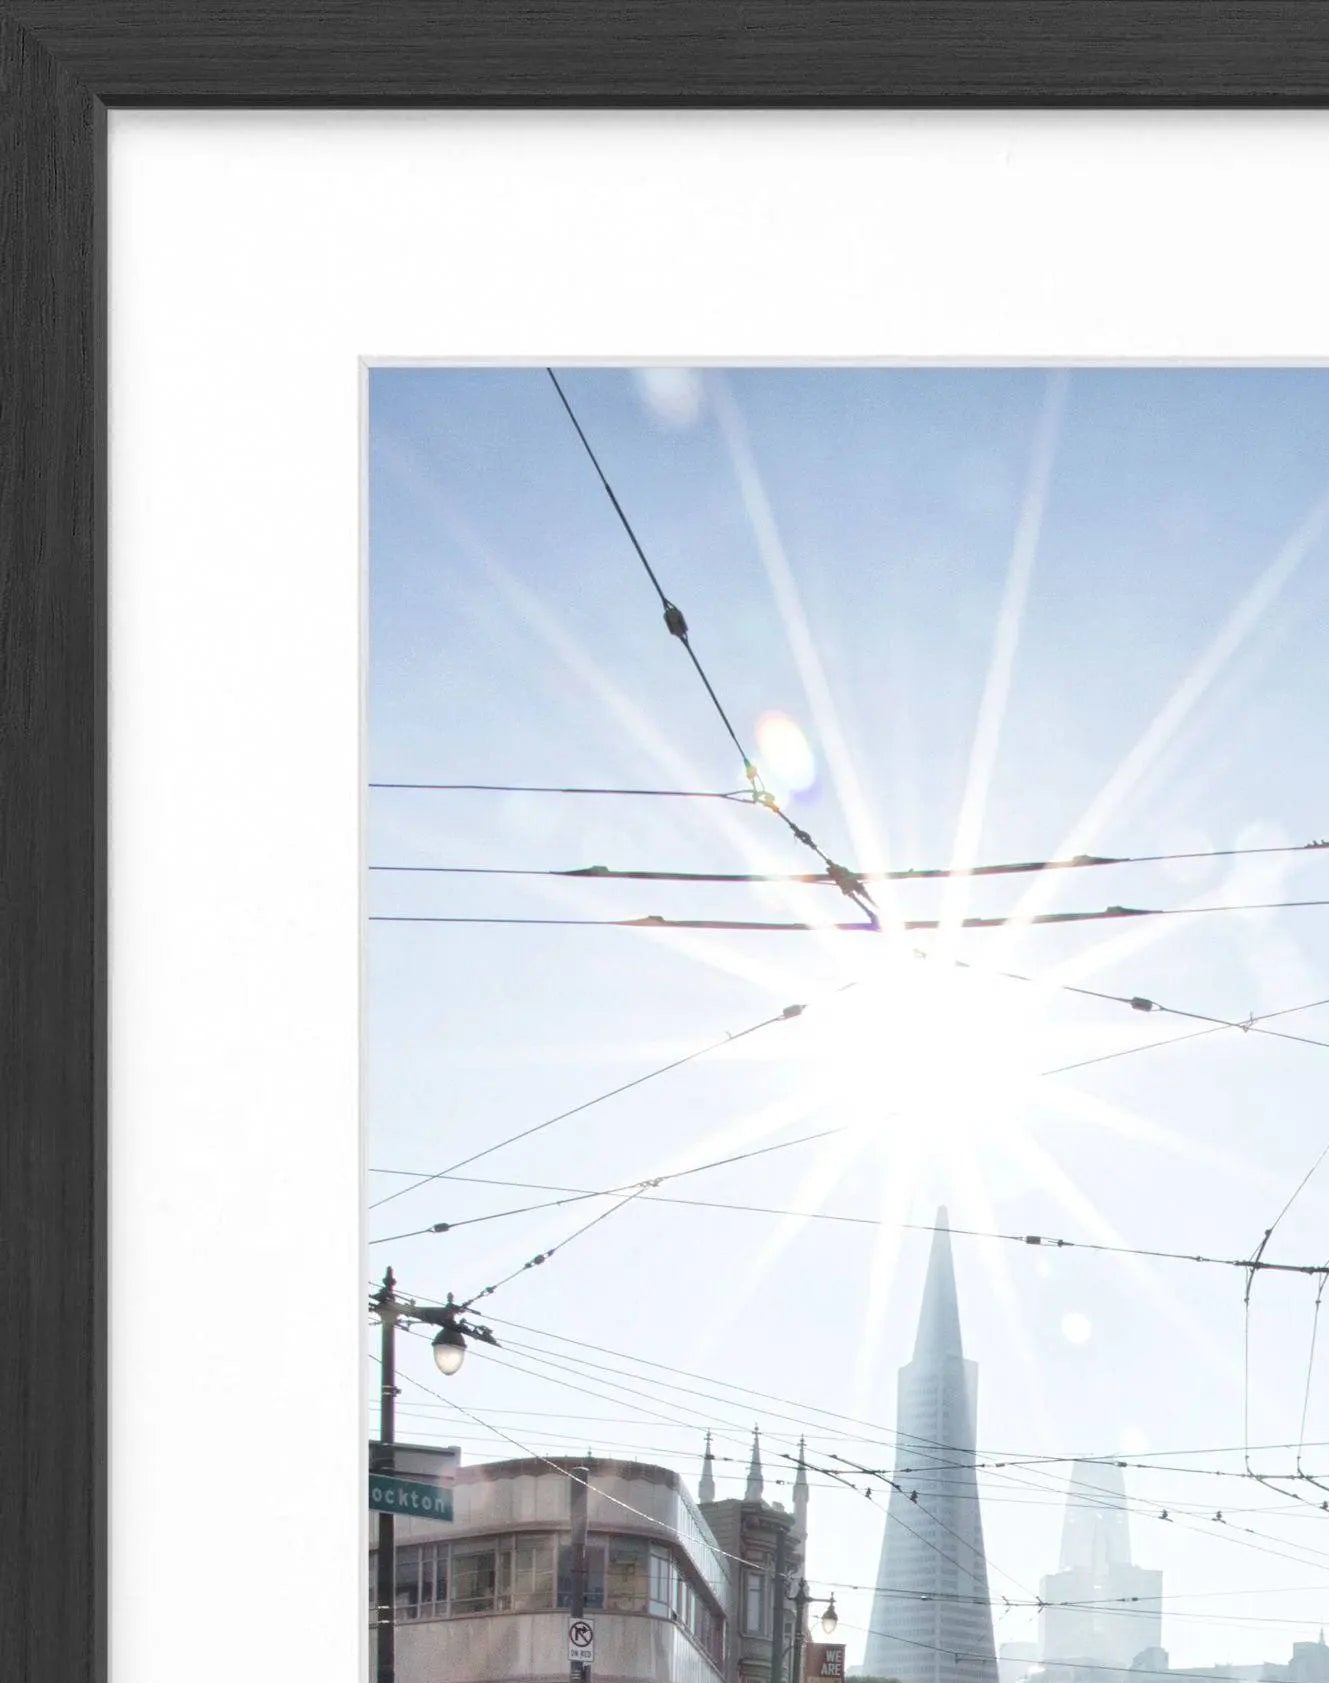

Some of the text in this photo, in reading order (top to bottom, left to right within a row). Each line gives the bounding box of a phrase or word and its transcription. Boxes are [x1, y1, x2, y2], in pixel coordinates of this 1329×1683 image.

[372, 1487, 445, 1513] ockton
[825, 1650, 841, 1662] WE
[821, 1663, 840, 1675] ARE
